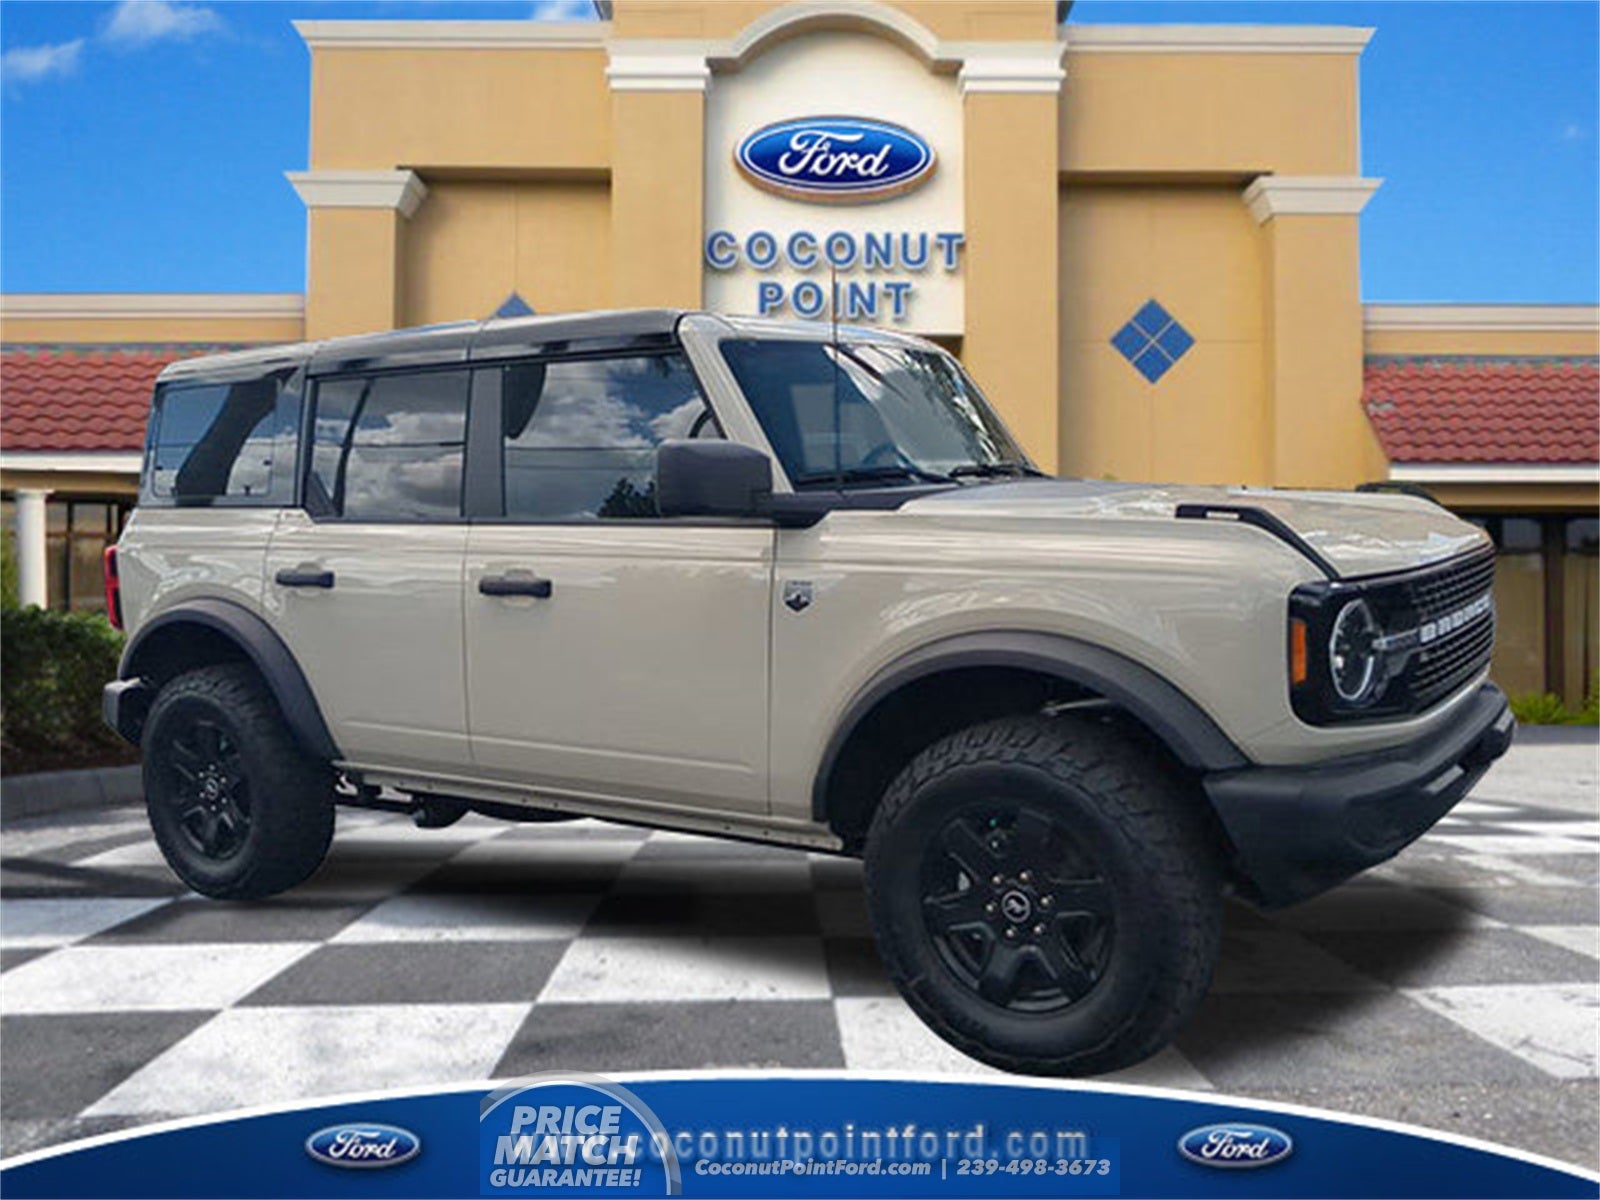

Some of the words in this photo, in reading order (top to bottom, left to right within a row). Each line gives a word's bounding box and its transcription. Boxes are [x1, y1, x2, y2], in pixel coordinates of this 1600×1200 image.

[778, 129, 892, 177] Ford
[706, 230, 965, 269] COCONUT
[758, 281, 911, 317] POINT
